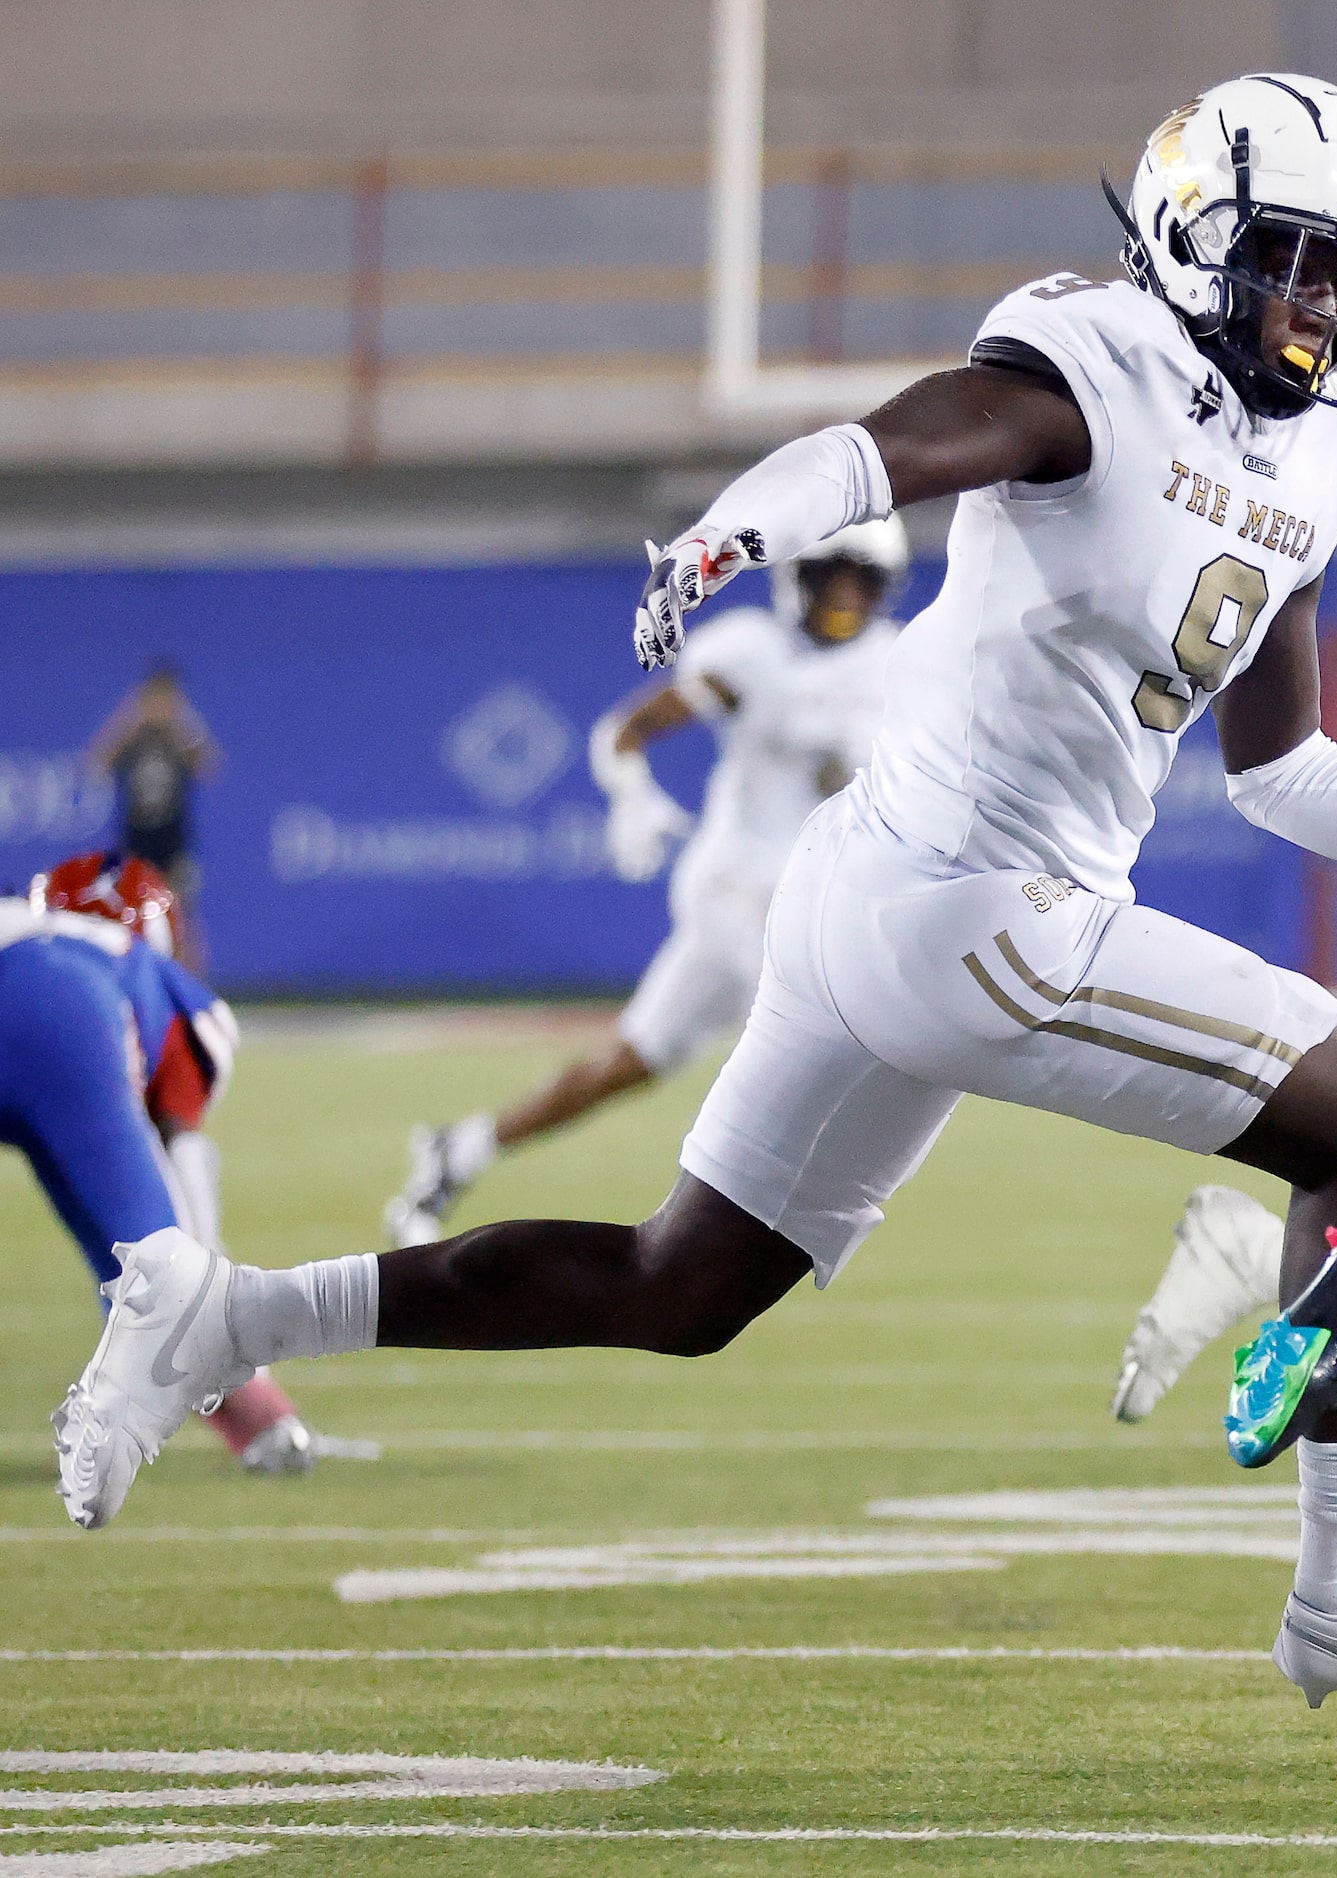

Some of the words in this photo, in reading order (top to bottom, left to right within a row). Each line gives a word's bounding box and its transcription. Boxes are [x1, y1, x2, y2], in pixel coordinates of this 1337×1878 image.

[1163, 460, 1230, 526] THE
[1238, 499, 1315, 563] MECCA
[1247, 457, 1277, 477] BATTLE
[1131, 552, 1269, 734] 9
